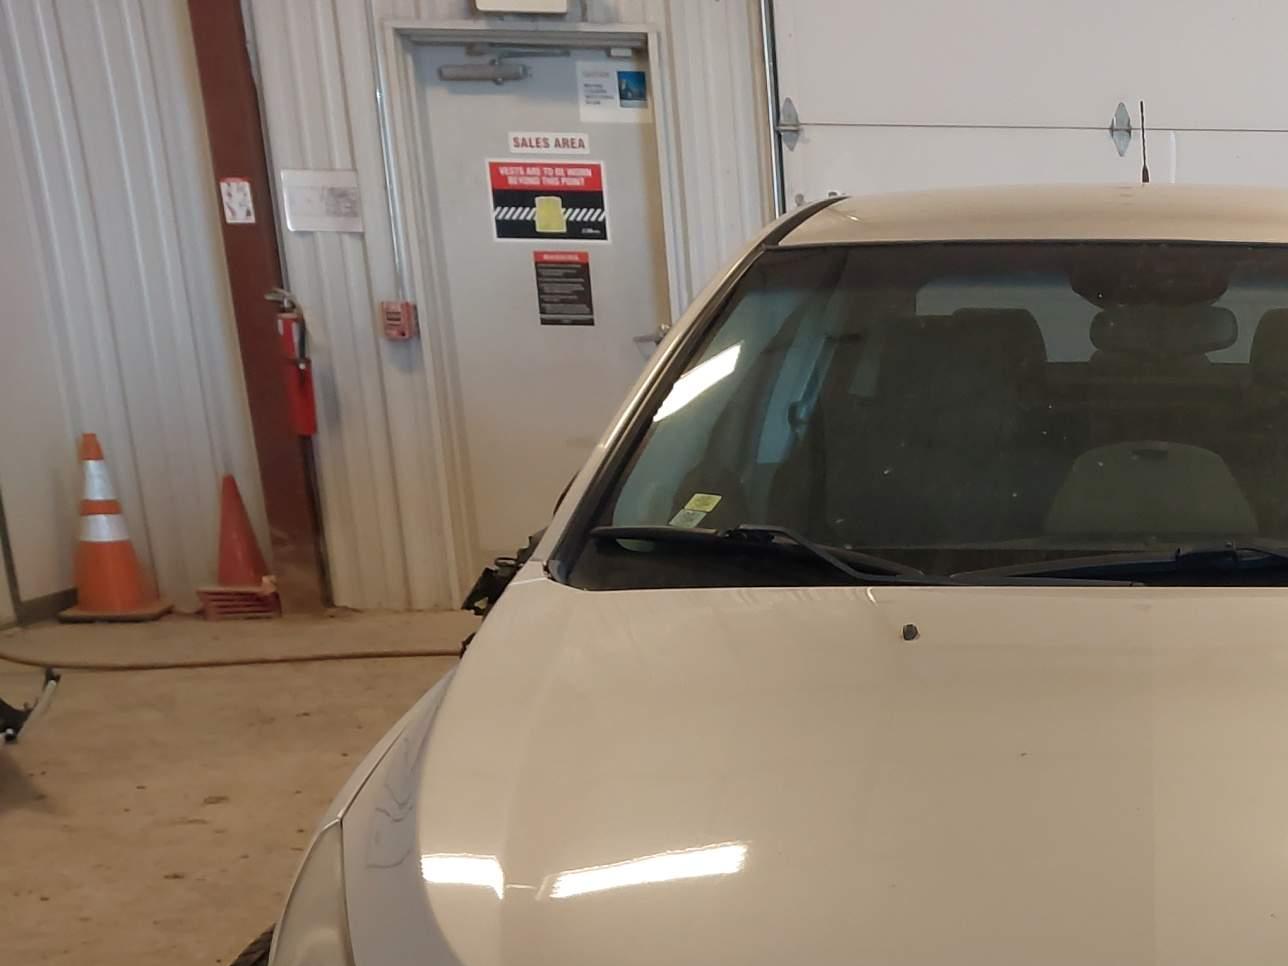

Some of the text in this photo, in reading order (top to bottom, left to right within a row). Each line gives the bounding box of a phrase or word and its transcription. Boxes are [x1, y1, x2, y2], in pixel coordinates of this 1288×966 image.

[513, 137, 586, 149] SALES AREA
[543, 167, 554, 176] TO
[542, 176, 560, 185] THIS
